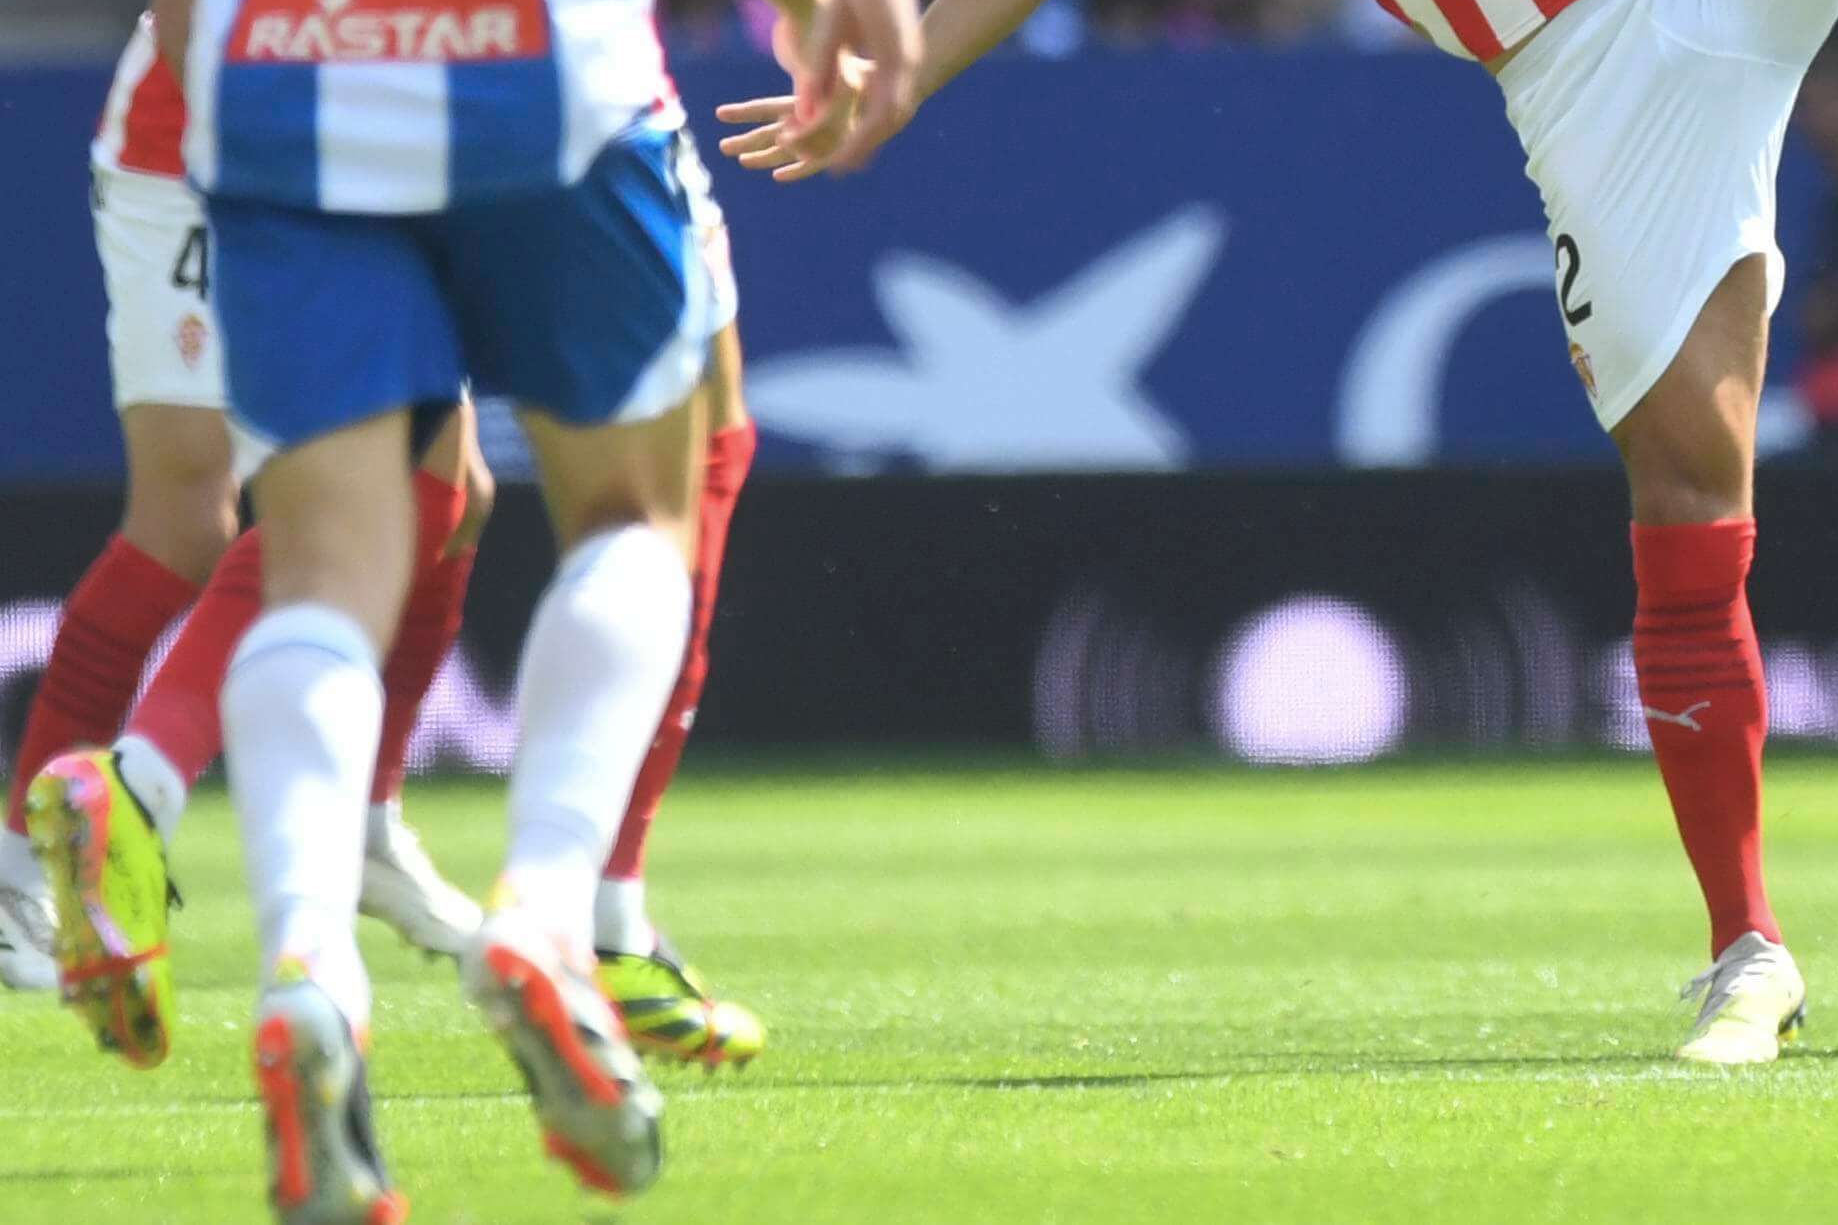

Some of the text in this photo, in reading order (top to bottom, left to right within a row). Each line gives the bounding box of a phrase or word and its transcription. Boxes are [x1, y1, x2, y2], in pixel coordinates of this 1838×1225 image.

[247, 3, 517, 60] RASTAR
[172, 225, 210, 301] 4
[1555, 233, 1593, 327] 2
